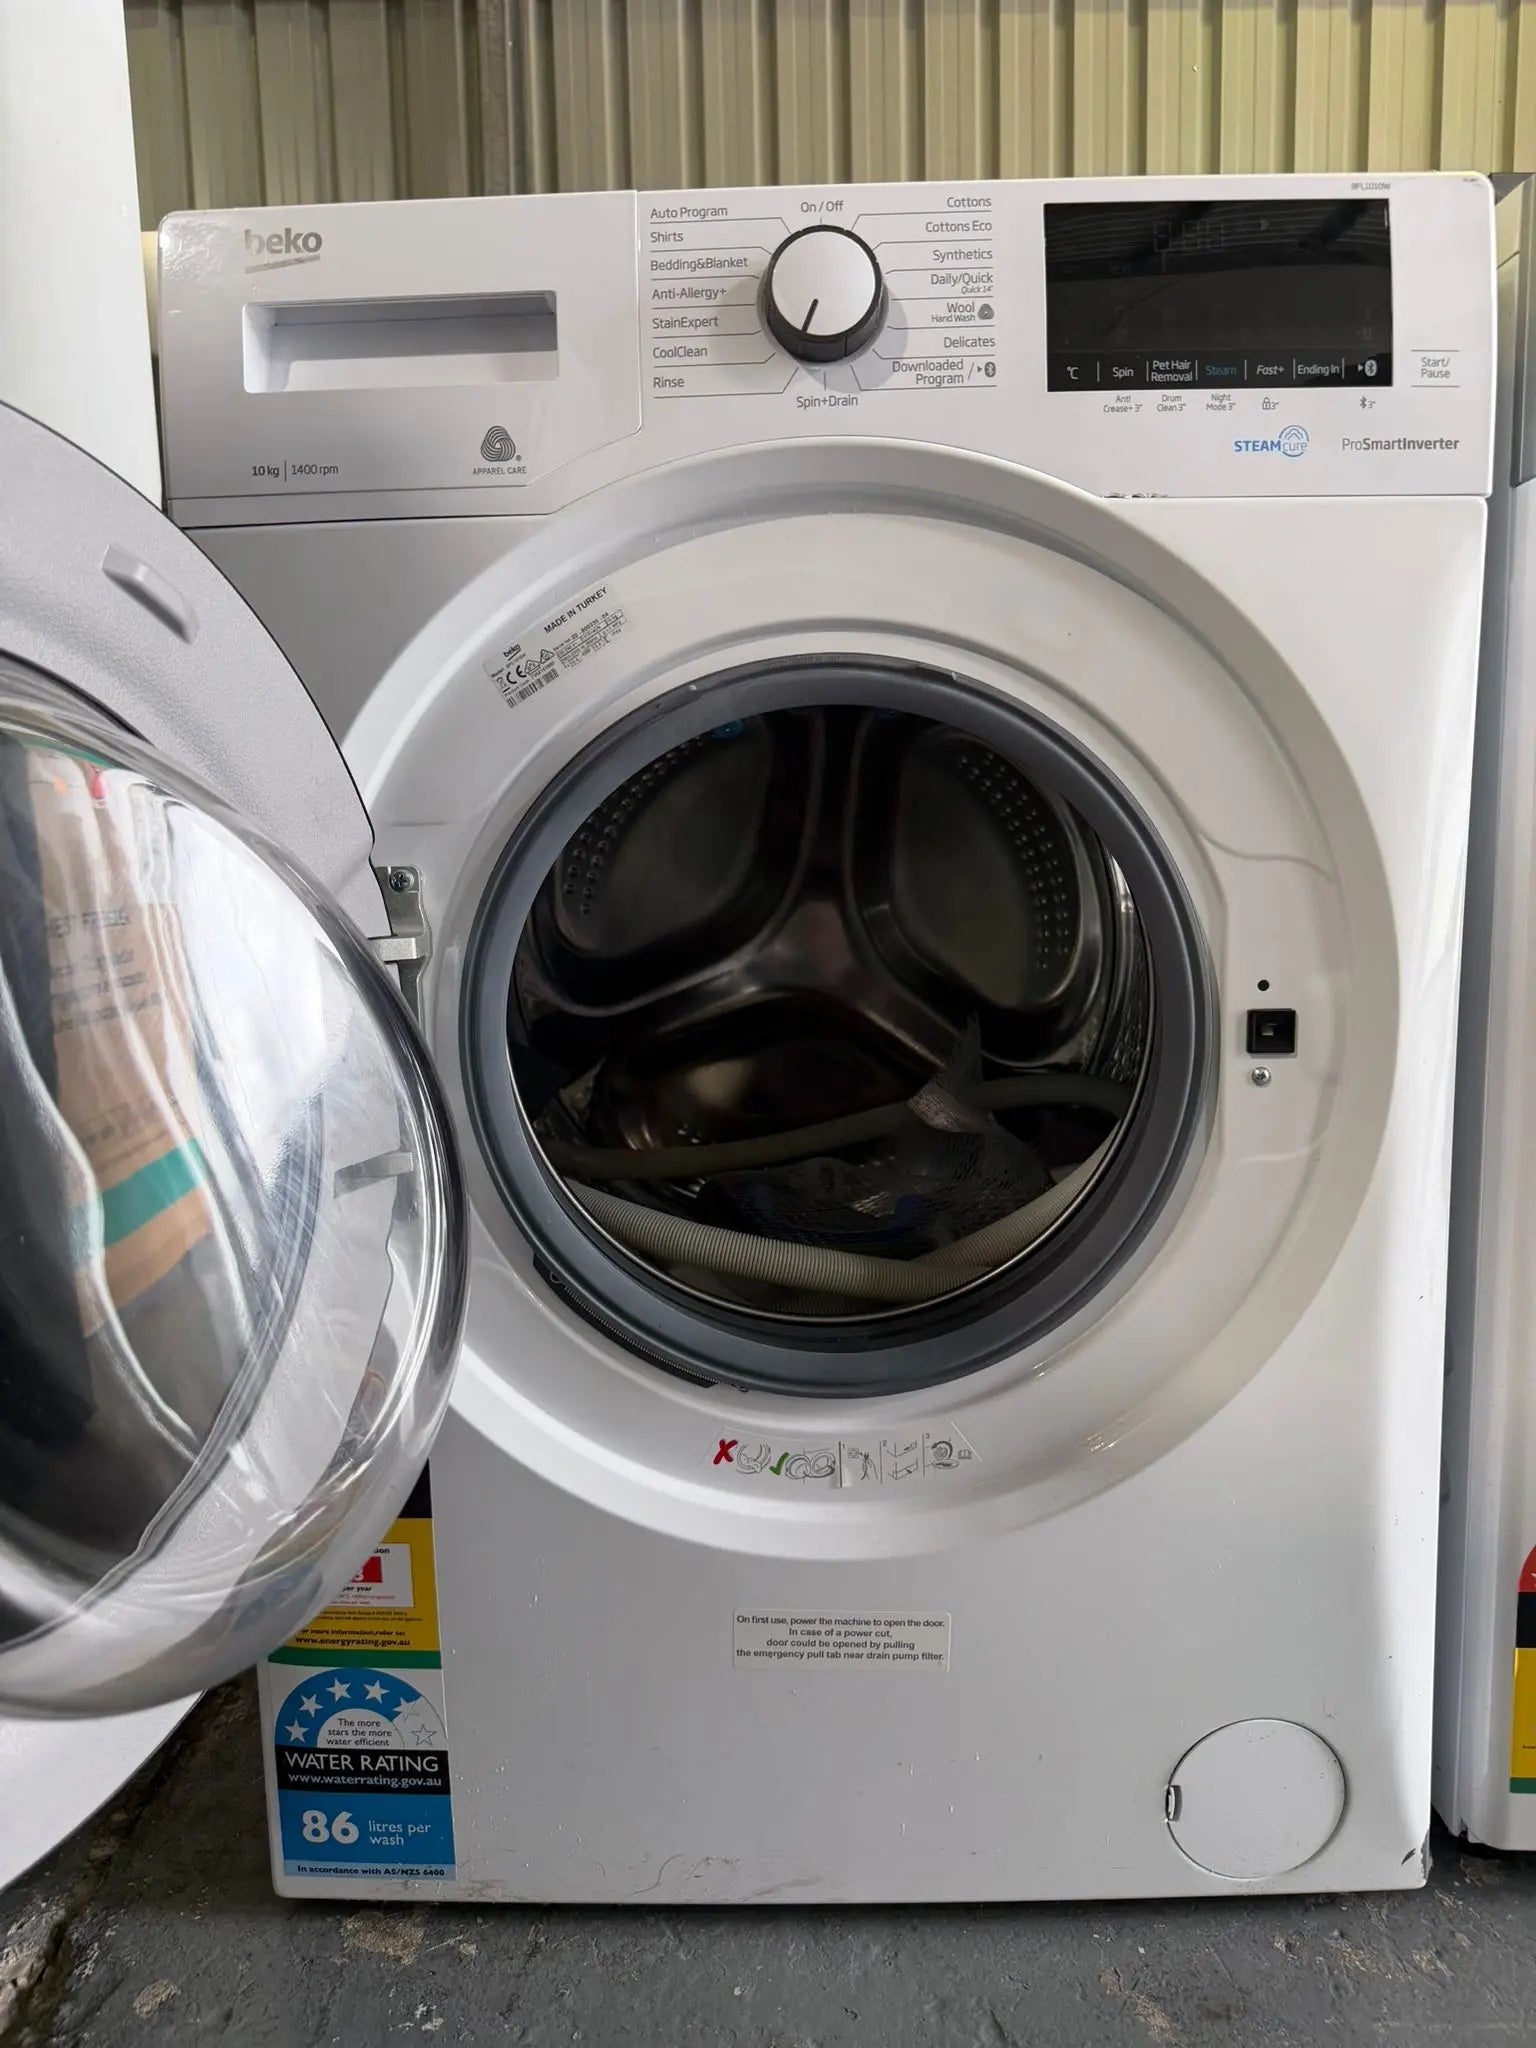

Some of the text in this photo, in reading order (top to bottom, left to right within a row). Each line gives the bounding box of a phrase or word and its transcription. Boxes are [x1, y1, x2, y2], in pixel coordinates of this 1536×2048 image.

[800, 202, 816, 213] On
[826, 200, 844, 212] Off
[946, 197, 992, 208] Cottons
[650, 207, 728, 220] Auto Program
[925, 220, 992, 233] Cottons Eco
[244, 227, 322, 256] beko
[650, 231, 684, 243] Shirts
[932, 249, 993, 263] Synthetics
[650, 257, 749, 273] Bedding&Blanket
[930, 272, 994, 286] Daily/Quick
[652, 287, 727, 300] Anti-Allergy+
[961, 285, 981, 295] Quick
[946, 302, 975, 313] Wool
[652, 316, 720, 329] StainExpert
[931, 313, 976, 323] Hand Wash
[943, 336, 996, 348] Delicates
[652, 346, 708, 359] CoolClean
[892, 359, 964, 373] Downloaded
[1152, 360, 1192, 370] Pet Hair
[1420, 357, 1450, 368] Start/
[1112, 366, 1135, 379] Spin
[1151, 371, 1193, 382] Removal
[1205, 365, 1237, 376] Steam
[1256, 364, 1285, 376] Fast+
[1297, 364, 1340, 377] Ending In
[1420, 368, 1451, 379] Pause
[653, 376, 685, 388] Rinse
[915, 373, 964, 387] Program
[796, 394, 859, 410] Spin+Drain
[1115, 395, 1131, 404] Anti
[1161, 394, 1182, 402] Drum
[1211, 393, 1232, 405] Night
[1103, 404, 1133, 413] Crease+
[1157, 403, 1177, 412] Clean
[1206, 402, 1226, 411] Mode
[1342, 437, 1459, 451] ProSmartInverter
[251, 465, 280, 478] 10 kg
[291, 464, 339, 477] 1400 rpm
[472, 466, 527, 476] APPAREL CARE
[543, 615, 569, 634] MADE
[566, 607, 577, 619] IN
[575, 587, 608, 612] TURKEY
[502, 643, 521, 658] beko
[356, 1585, 372, 1593] year
[736, 1615, 750, 1624] On
[752, 1615, 769, 1624] first
[770, 1616, 789, 1625] use,
[790, 1617, 818, 1626] power
[819, 1617, 833, 1625] the
[834, 1617, 872, 1626] machine
[883, 1619, 906, 1628] open
[907, 1619, 921, 1627] the
[923, 1619, 945, 1627] door.
[788, 1628, 798, 1636] In
[800, 1628, 822, 1636] case
[824, 1628, 834, 1636] of
[843, 1630, 873, 1638] power
[875, 1630, 893, 1638] cut,
[295, 1637, 411, 1647] www.energyrating.gov.au
[766, 1638, 916, 1651] door could be opened by pulling
[736, 1648, 752, 1657] the
[753, 1649, 805, 1659] emergency
[807, 1650, 824, 1660] pull
[826, 1650, 842, 1659] tab
[866, 1651, 890, 1660] drain
[892, 1652, 920, 1662] pump
[921, 1652, 945, 1661] filter.
[338, 1718, 381, 1727] The more
[327, 1728, 393, 1737] stars the more
[326, 1737, 390, 1746] water efficient
[285, 1751, 439, 1773] WATER RATING
[288, 1773, 442, 1788] www.waterrating.gov.au
[302, 1809, 360, 1845] 86
[368, 1820, 432, 1836] litres per
[369, 1833, 405, 1846] wash
[297, 1865, 445, 1877] In accordance with AS/NZS 6400
